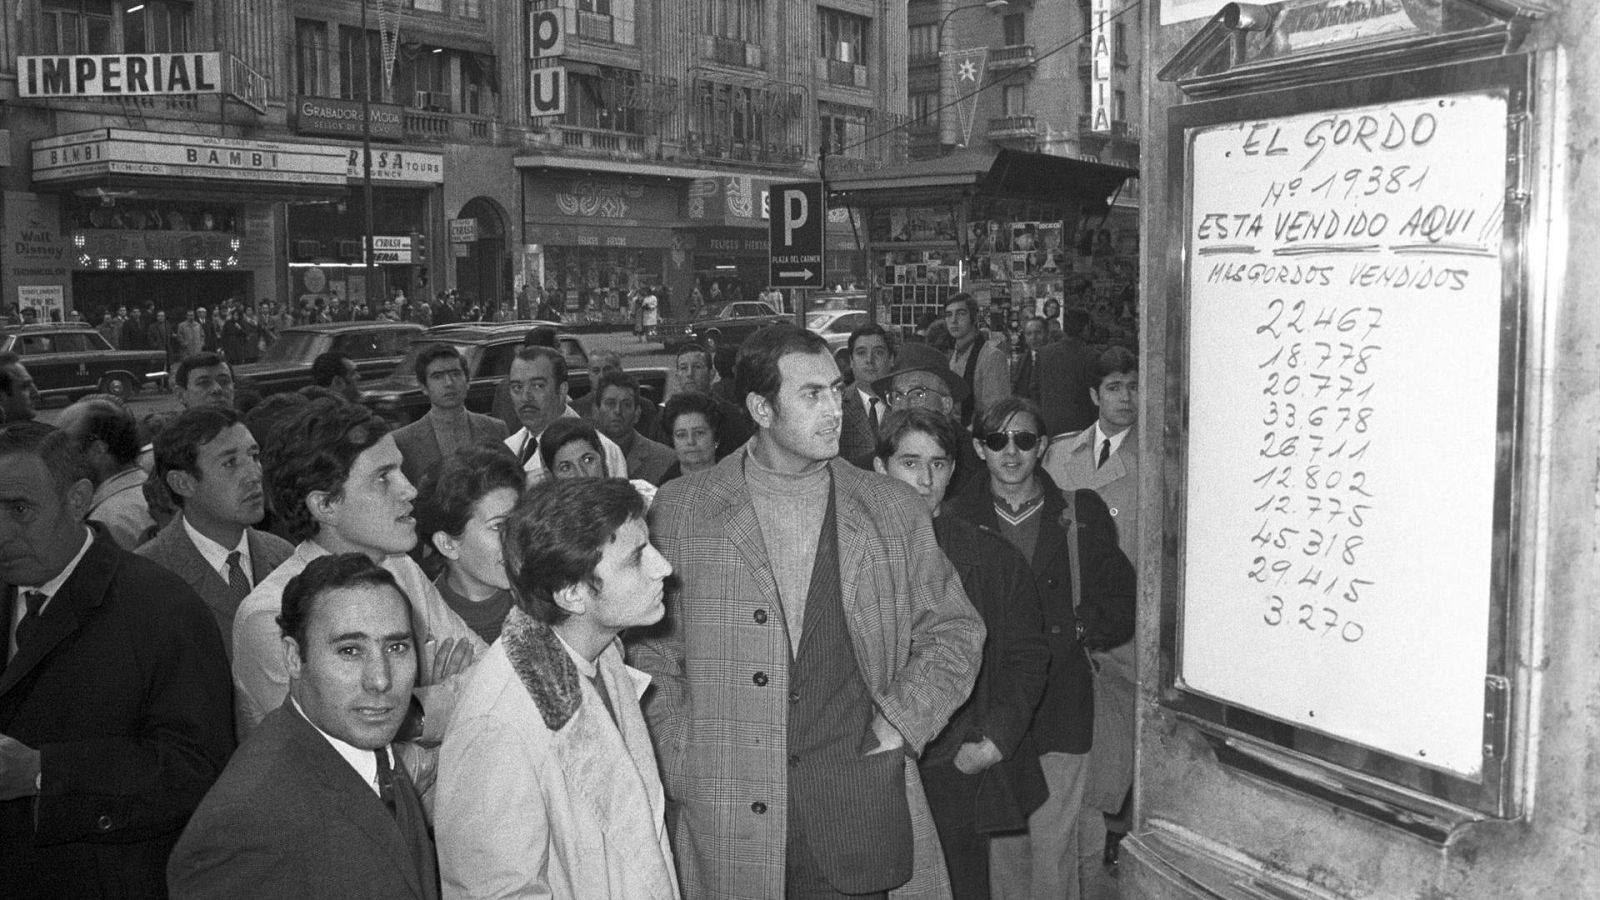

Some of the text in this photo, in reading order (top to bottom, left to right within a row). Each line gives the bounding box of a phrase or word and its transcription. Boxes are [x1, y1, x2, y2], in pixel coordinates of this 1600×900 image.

[27, 55, 215, 95] IMPERIAL
[1300, 113, 1437, 172] GORDO
[51, 145, 100, 165] BAMBI
[186, 148, 278, 168] BAMBI
[406, 162, 439, 173] TOURS
[784, 189, 809, 246] P
[1198, 213, 1264, 240] ESTA
[1274, 210, 1389, 243] VENDIDO
[21, 231, 52, 242] Walt
[15, 242, 64, 259] Disney
[772, 254, 820, 264] PLAZA DEL CARMEN
[1350, 260, 1469, 291] VENDIDOS
